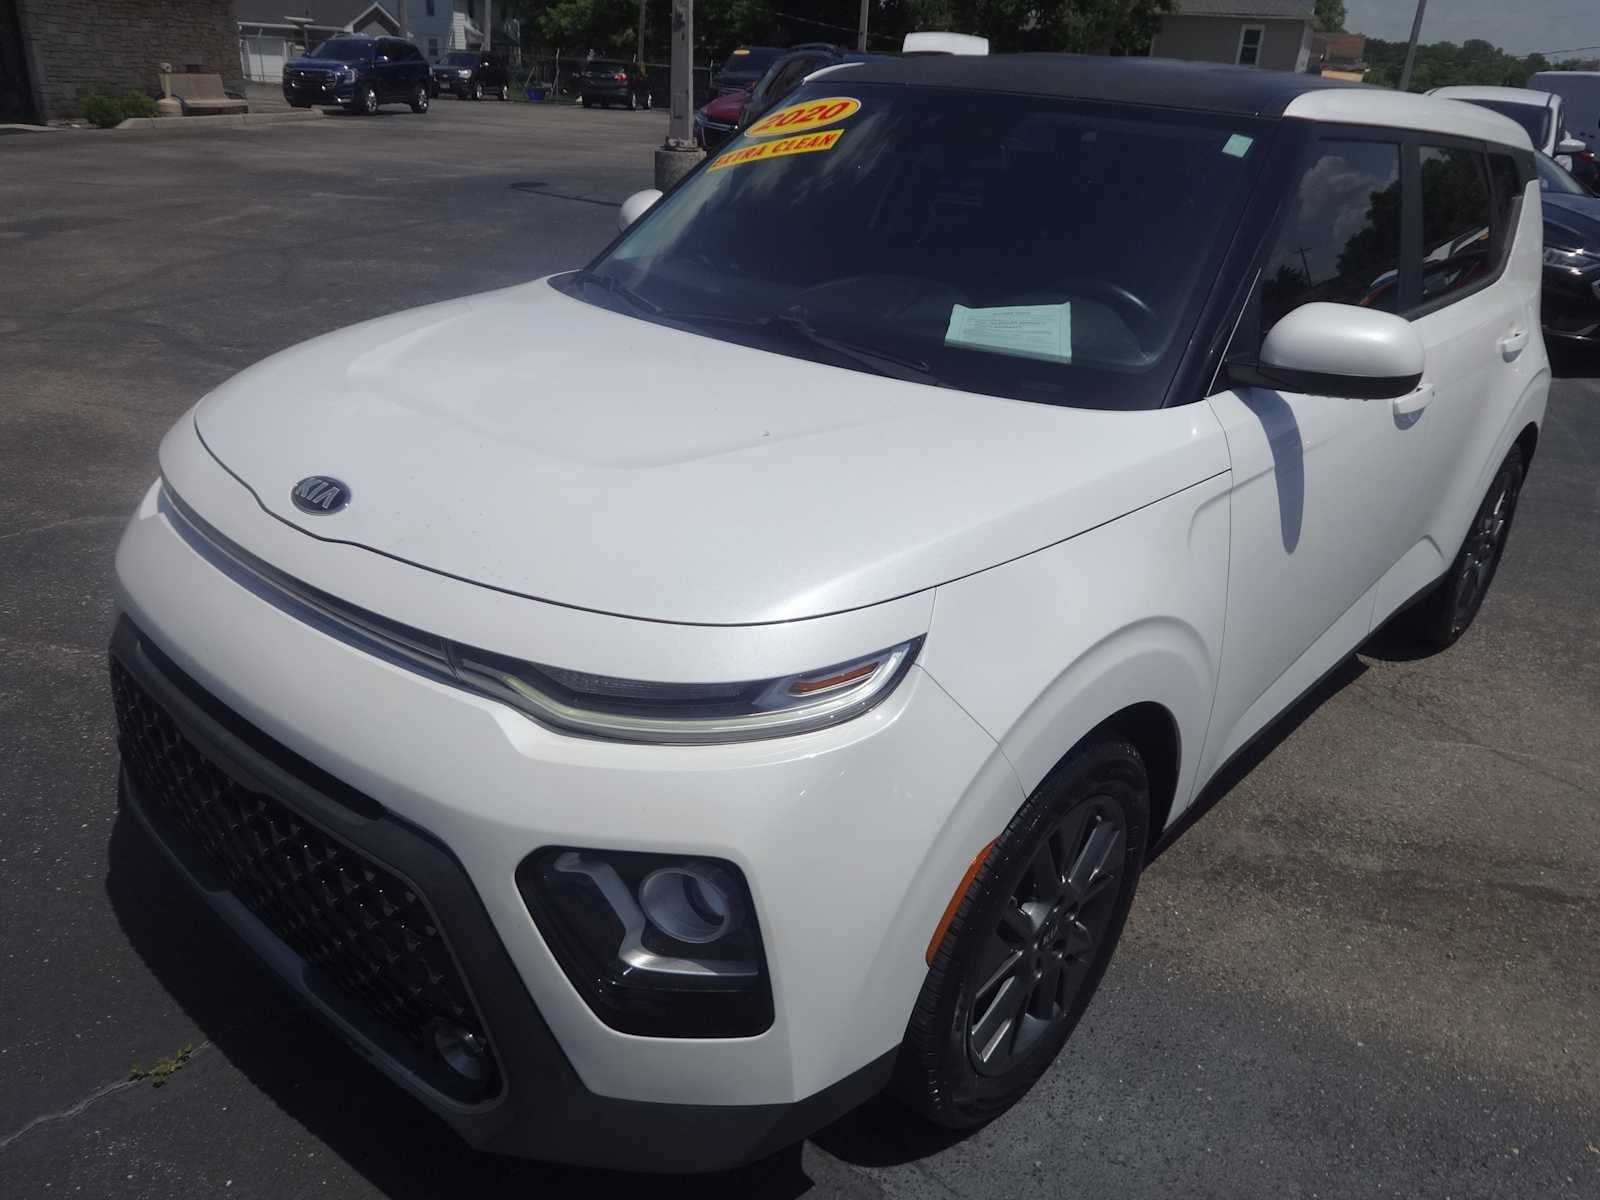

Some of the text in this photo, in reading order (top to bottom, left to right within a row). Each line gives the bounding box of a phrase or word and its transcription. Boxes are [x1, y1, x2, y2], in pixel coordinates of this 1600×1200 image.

[753, 102, 850, 133] 2020
[712, 134, 836, 169] EXTRA CLEAN
[295, 479, 341, 509] KIA
